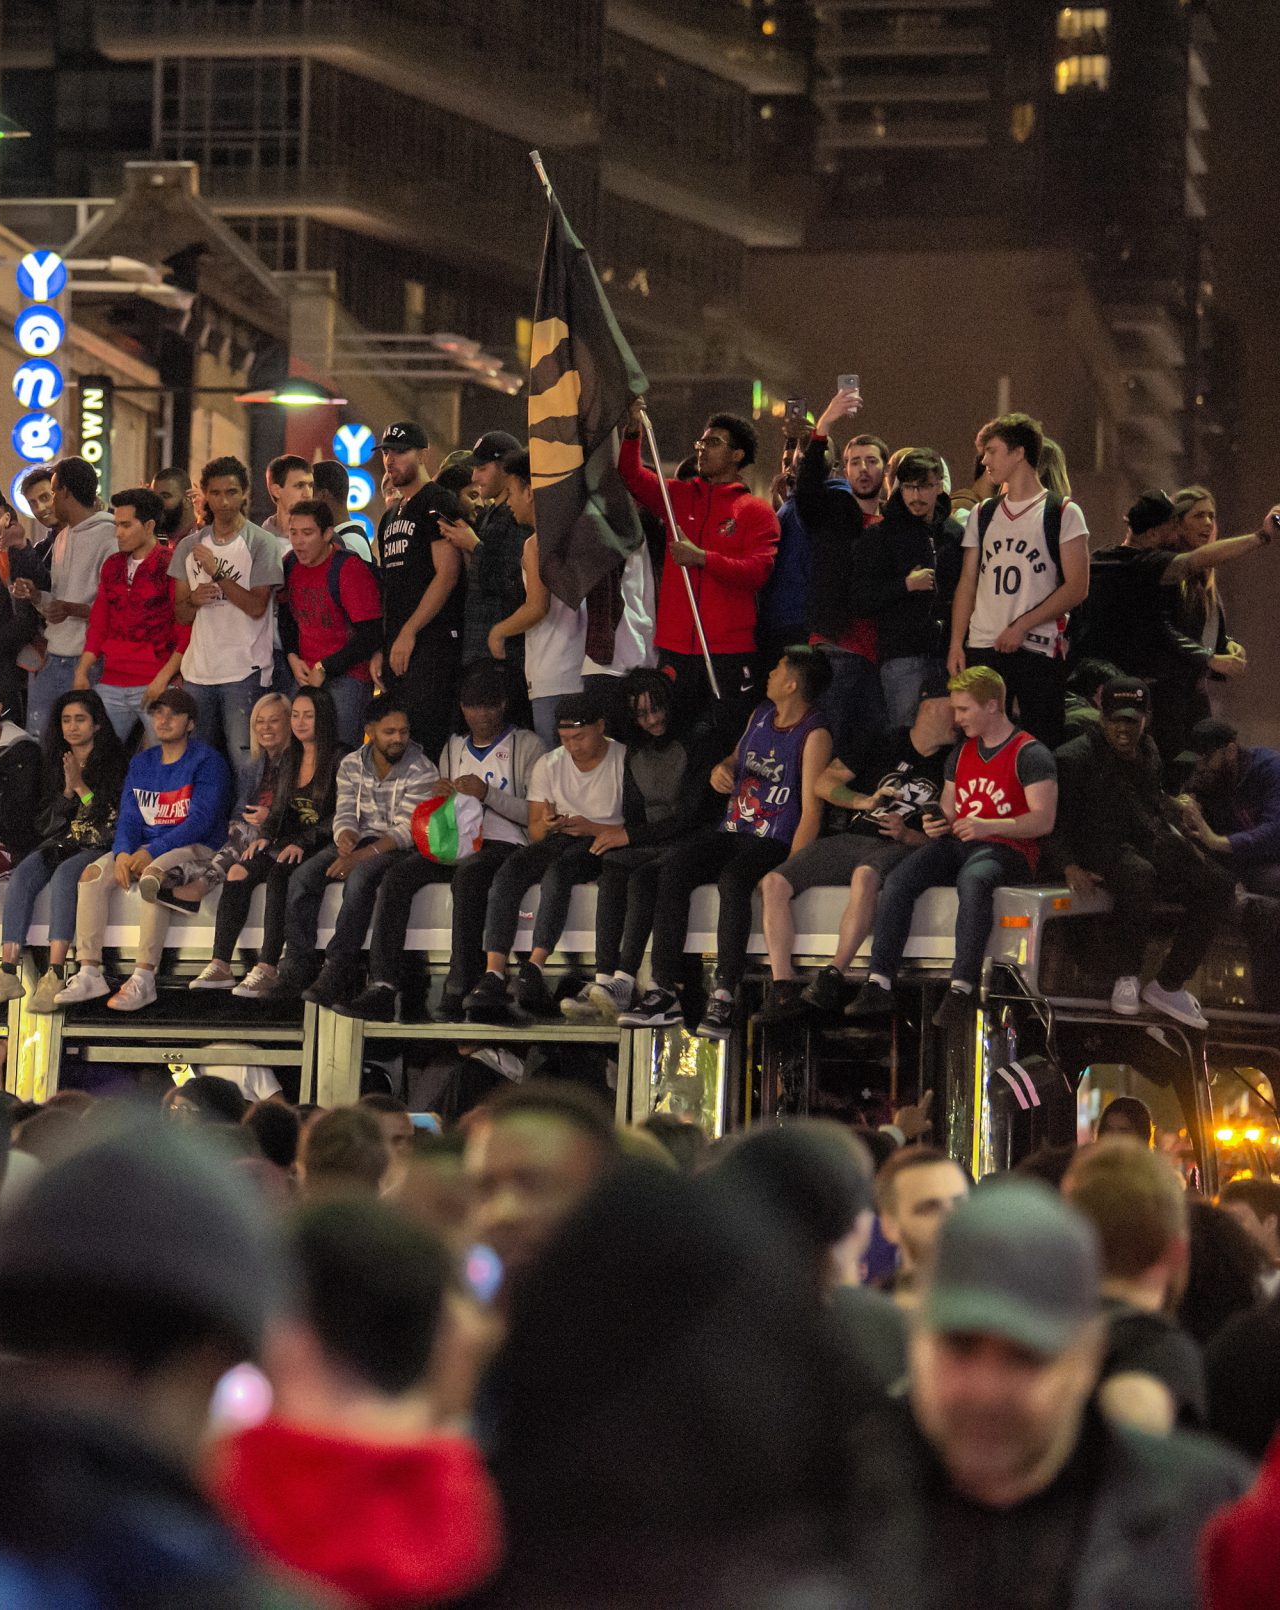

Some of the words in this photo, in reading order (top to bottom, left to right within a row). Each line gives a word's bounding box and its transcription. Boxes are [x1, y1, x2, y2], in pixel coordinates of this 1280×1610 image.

[81, 388, 103, 496] OWN
[384, 539, 409, 558] CHAMP
[980, 538, 1047, 574] RAPTORS
[993, 565, 1021, 595] 10
[765, 785, 790, 805] 10
[954, 777, 1012, 816] RAPTORS
